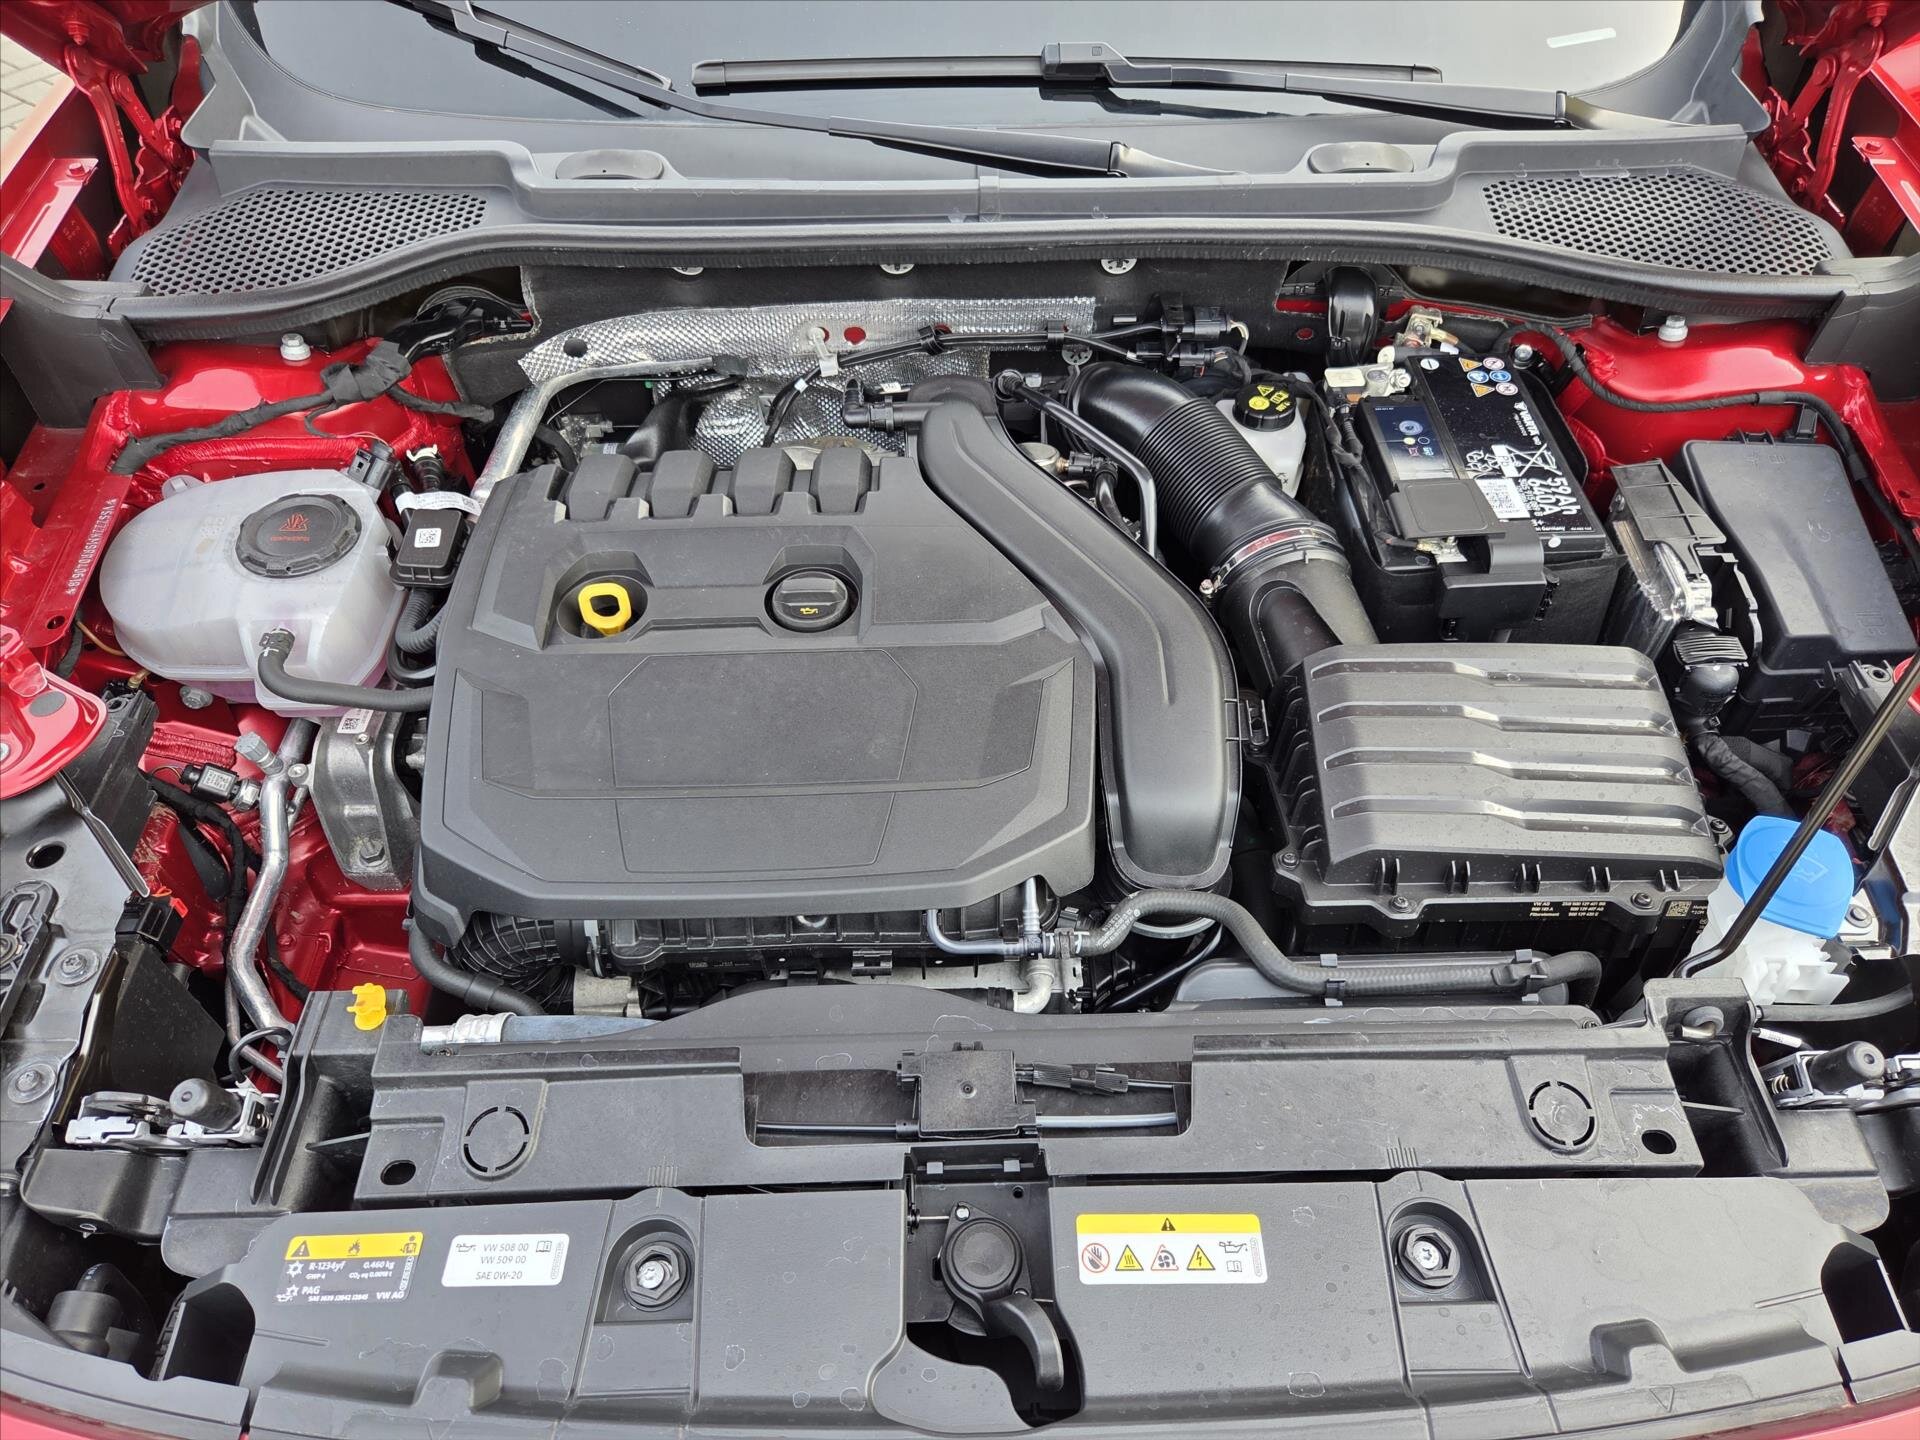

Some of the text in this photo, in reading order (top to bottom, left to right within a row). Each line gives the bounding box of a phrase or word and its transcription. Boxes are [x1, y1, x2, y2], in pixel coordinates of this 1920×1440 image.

[1519, 409, 1540, 436] VARTA
[1527, 477, 1562, 516] 640A
[1546, 477, 1581, 515] 59Ah
[483, 1243, 530, 1252] VW 508 00
[480, 1255, 527, 1265] VW 509 00
[309, 1261, 346, 1274] R-1234yf
[386, 1260, 396, 1272] kg
[475, 1270, 523, 1281] SAE 0W-20
[301, 1286, 321, 1296] PAG
[376, 1291, 392, 1300] VW
[391, 1291, 405, 1300] AG
